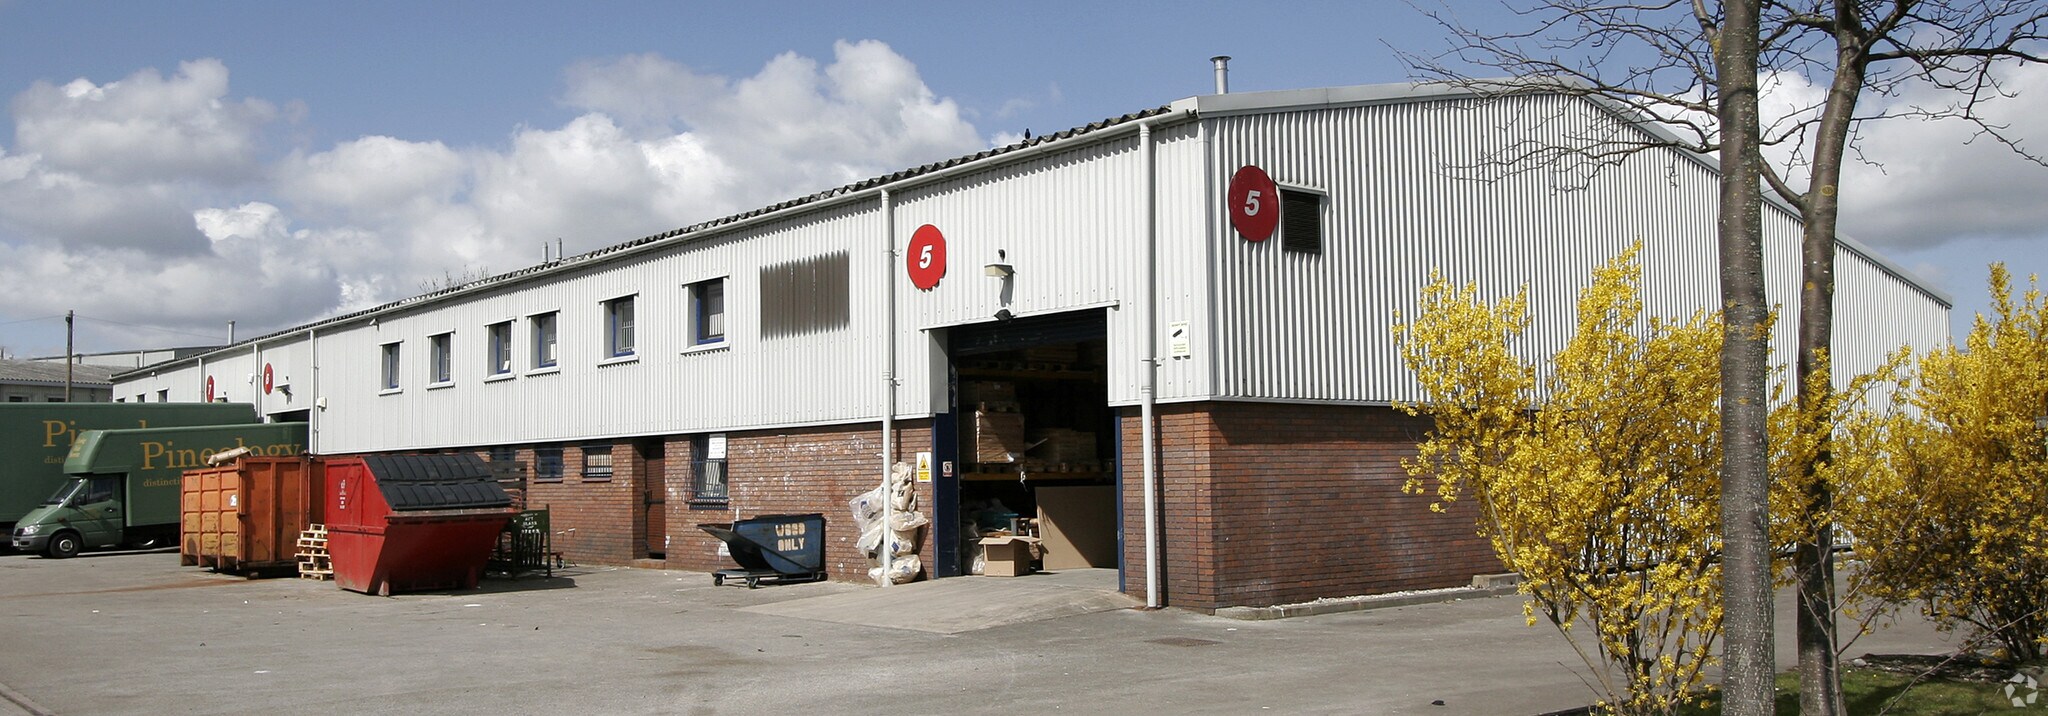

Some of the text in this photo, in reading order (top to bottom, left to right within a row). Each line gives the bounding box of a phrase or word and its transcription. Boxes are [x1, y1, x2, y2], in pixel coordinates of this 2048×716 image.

[1244, 190, 1261, 216] 5
[919, 244, 933, 269] 5
[775, 522, 806, 537] WOOD
[777, 537, 805, 551] ONLY
